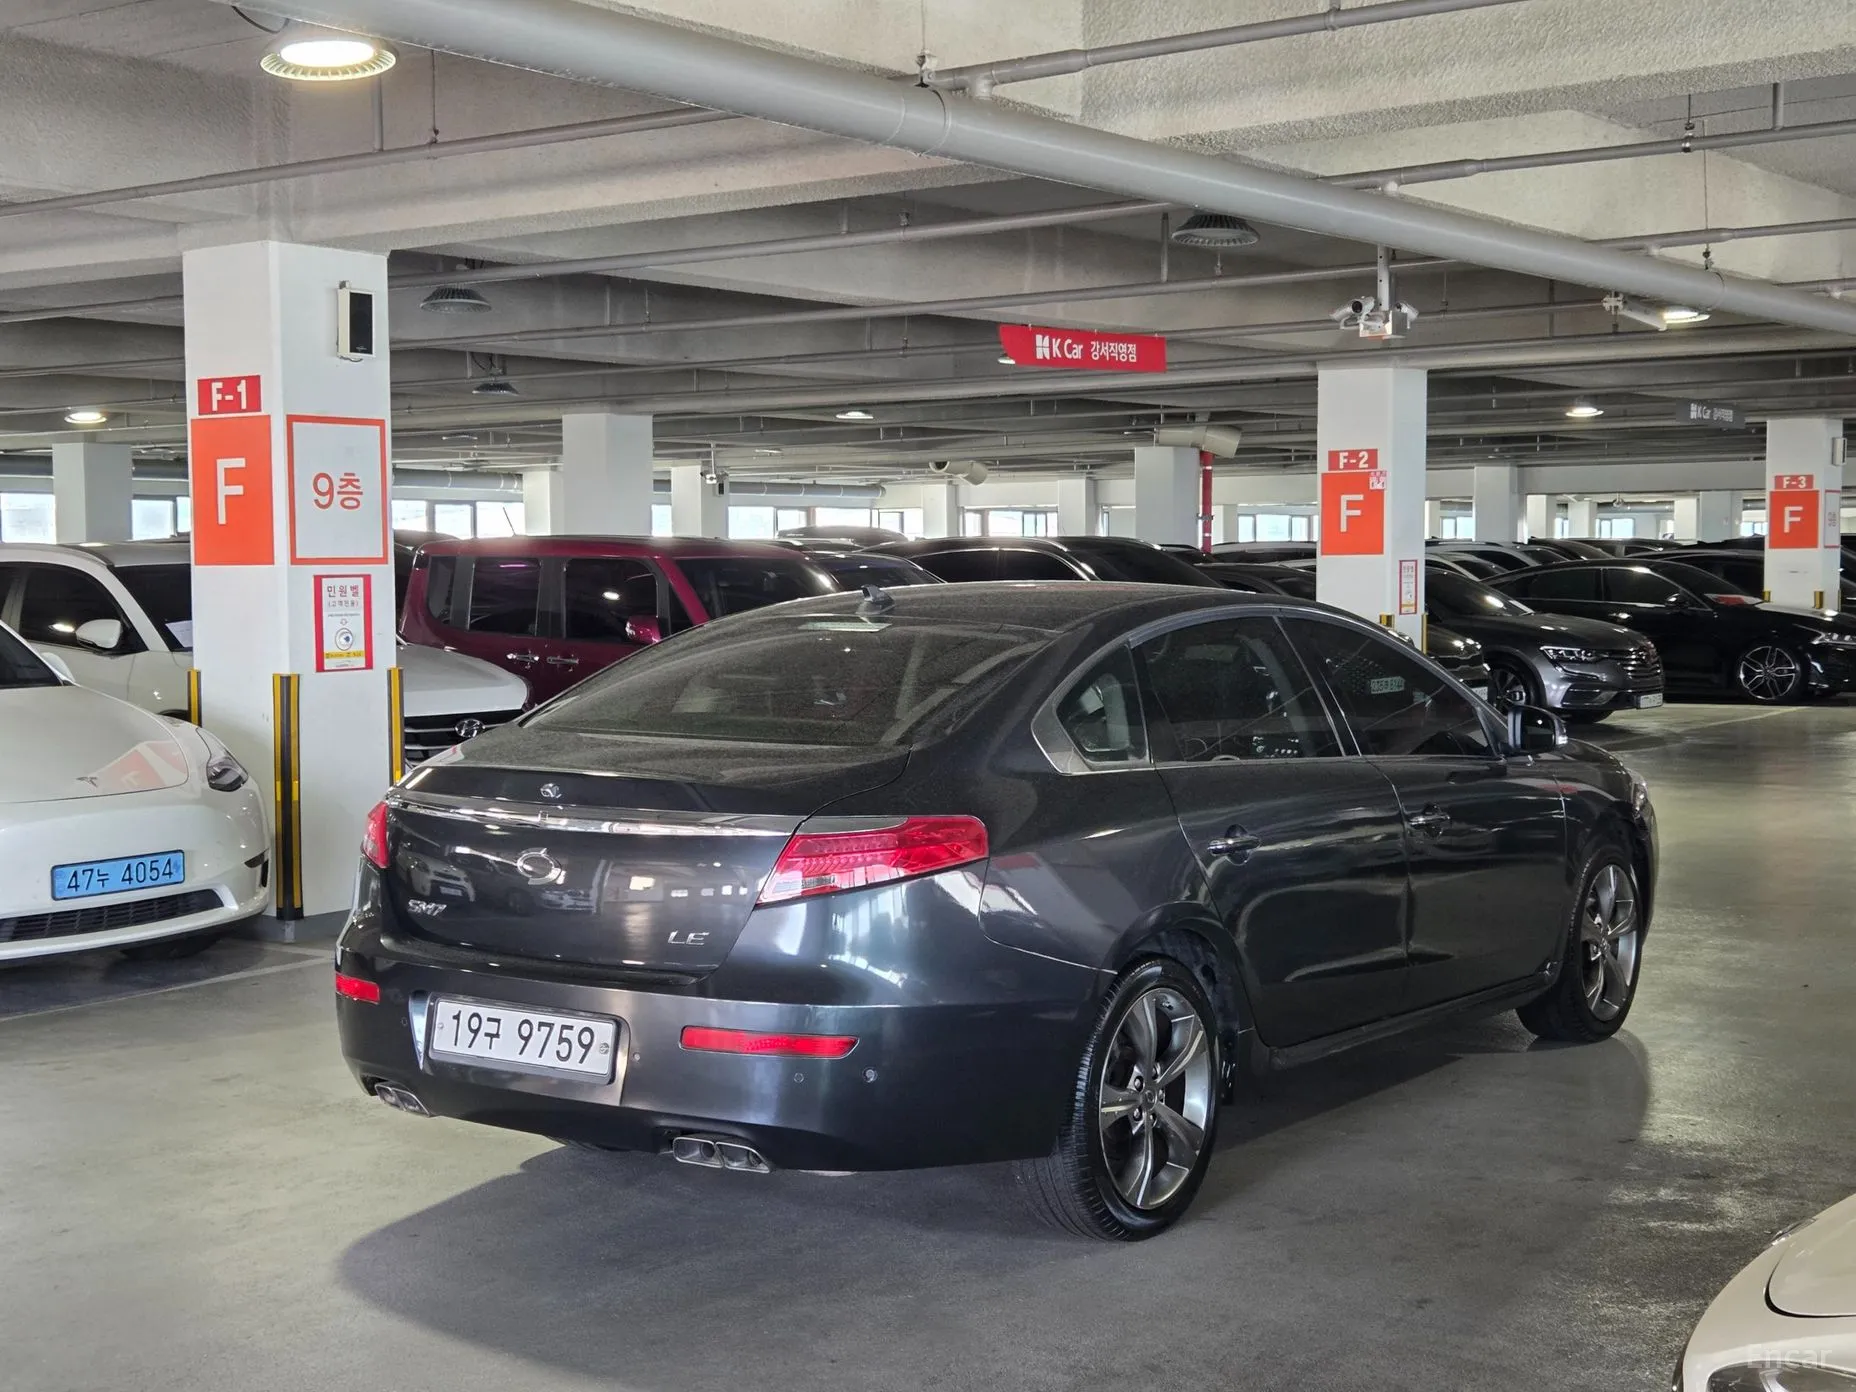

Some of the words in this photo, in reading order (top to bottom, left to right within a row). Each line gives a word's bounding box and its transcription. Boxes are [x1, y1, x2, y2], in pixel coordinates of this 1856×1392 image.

[1053, 338, 1062, 358] K
[1064, 338, 1084, 360] Car
[1090, 341, 1137, 363] 강서직영점
[211, 379, 247, 412] F-1
[1339, 451, 1369, 469] F-2
[216, 457, 247, 525] F
[312, 472, 364, 510] 9층
[1783, 476, 1807, 489] F-3
[1340, 494, 1364, 533] F
[1783, 506, 1804, 533] F
[67, 868, 110, 893] 47누
[121, 857, 174, 885] 4054
[408, 899, 447, 917] SM7
[667, 930, 710, 946] LE
[452, 1009, 502, 1050] 19구
[517, 1018, 595, 1065] 9759
